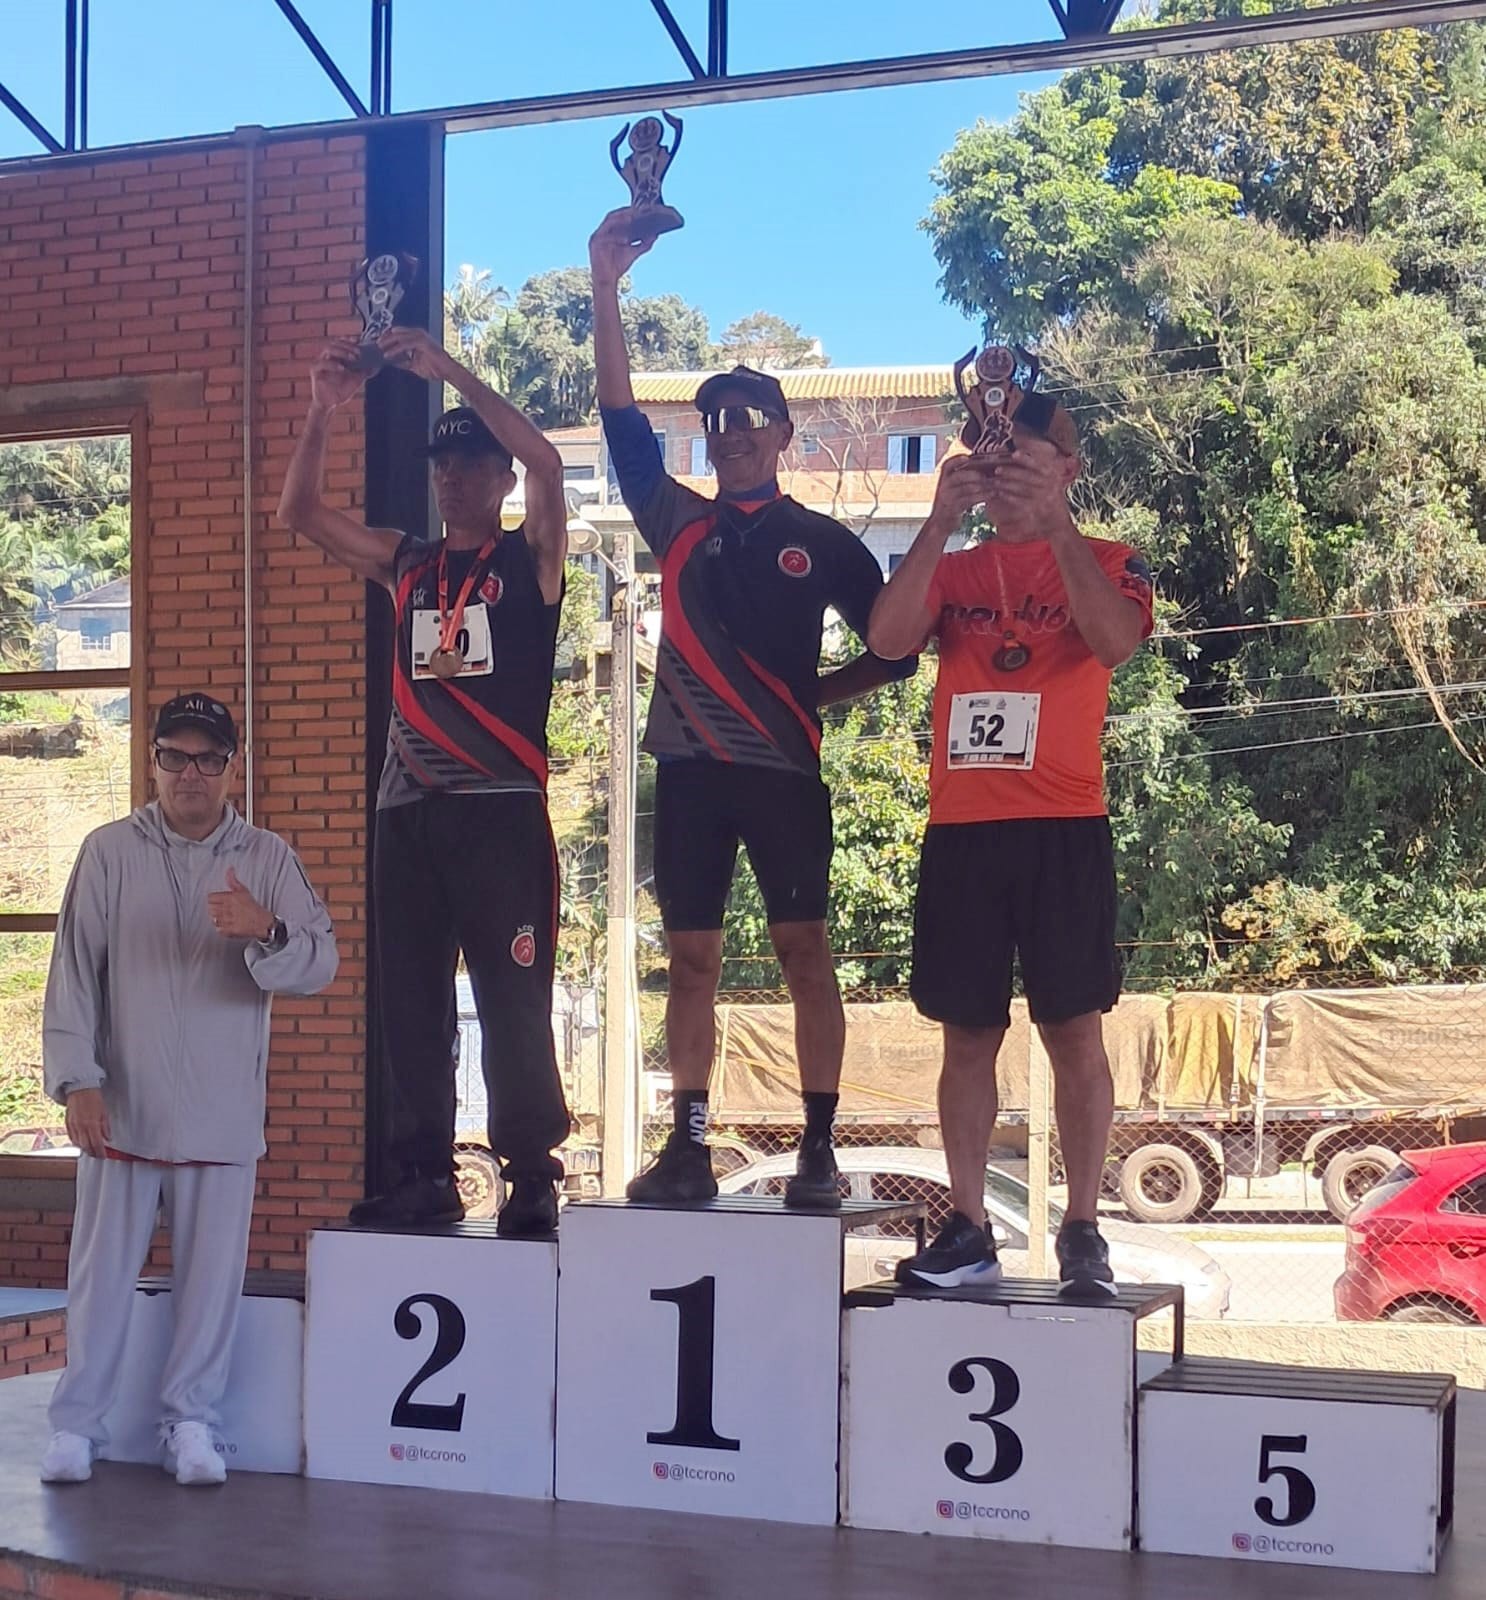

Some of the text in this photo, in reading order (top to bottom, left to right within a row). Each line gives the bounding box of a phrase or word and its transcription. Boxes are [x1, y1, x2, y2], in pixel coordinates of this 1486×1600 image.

[437, 420, 472, 438] NYC
[968, 713, 1005, 747] 52
[689, 1102, 707, 1146] RUN
[391, 1294, 465, 1432] 2
[647, 1276, 740, 1451] 1
[945, 1357, 1023, 1484] 3
[405, 1445, 467, 1463] @tccrono
[669, 1463, 736, 1482] @tccrono
[1255, 1435, 1315, 1526] 5
[955, 1501, 1031, 1522] @tccrono
[1252, 1534, 1335, 1556] @tccrono
